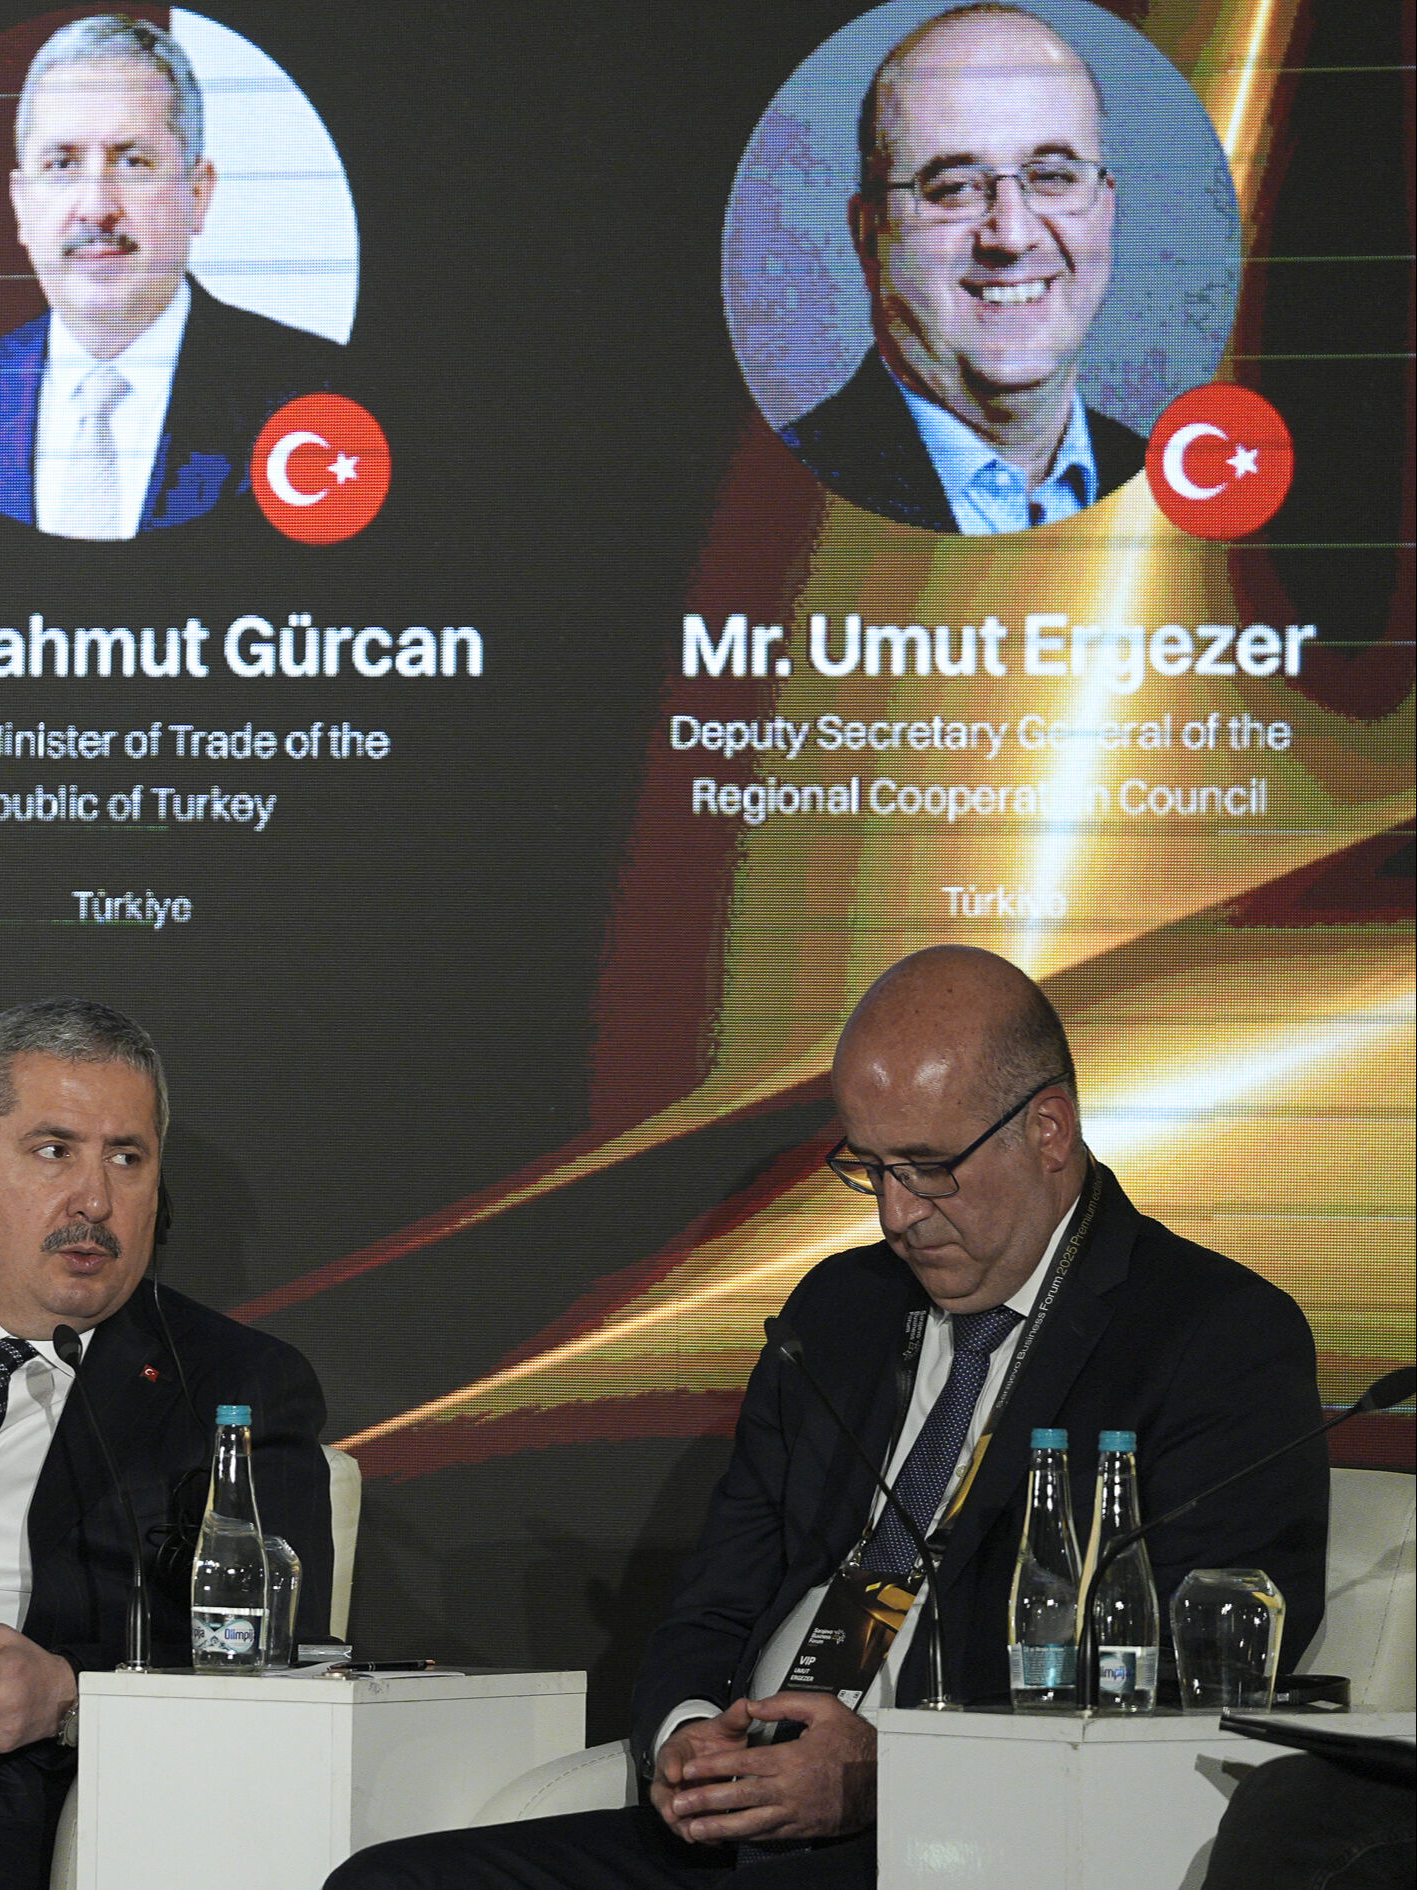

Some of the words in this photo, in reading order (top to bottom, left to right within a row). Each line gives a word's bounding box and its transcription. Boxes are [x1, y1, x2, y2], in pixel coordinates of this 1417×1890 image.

[223, 613, 483, 678] Gürcan
[682, 613, 793, 678] Mr.
[809, 613, 1008, 678] Umut
[1025, 614, 1318, 695] Ergezer
[123, 721, 163, 760] of
[168, 722, 278, 760] Trade
[284, 721, 323, 760] of
[328, 721, 391, 760] the
[669, 714, 810, 760] Deputy
[815, 713, 1009, 760] Secretary
[1018, 713, 1172, 750] Geeral
[1183, 712, 1220, 750] of
[1228, 712, 1294, 750] the
[107, 784, 144, 822] of
[151, 785, 277, 831] Turkey
[692, 776, 860, 826] Regional
[1120, 777, 1268, 816] Council
[70, 888, 193, 930] Türkiye
[996, 1361, 1022, 1409] Sarajevo
[1016, 1311, 1047, 1360] Business
[1039, 1276, 1065, 1312] Forum
[1056, 1245, 1078, 1276] 2025
[1070, 1200, 1099, 1246] Premium
[799, 1655, 817, 1666] VIP
